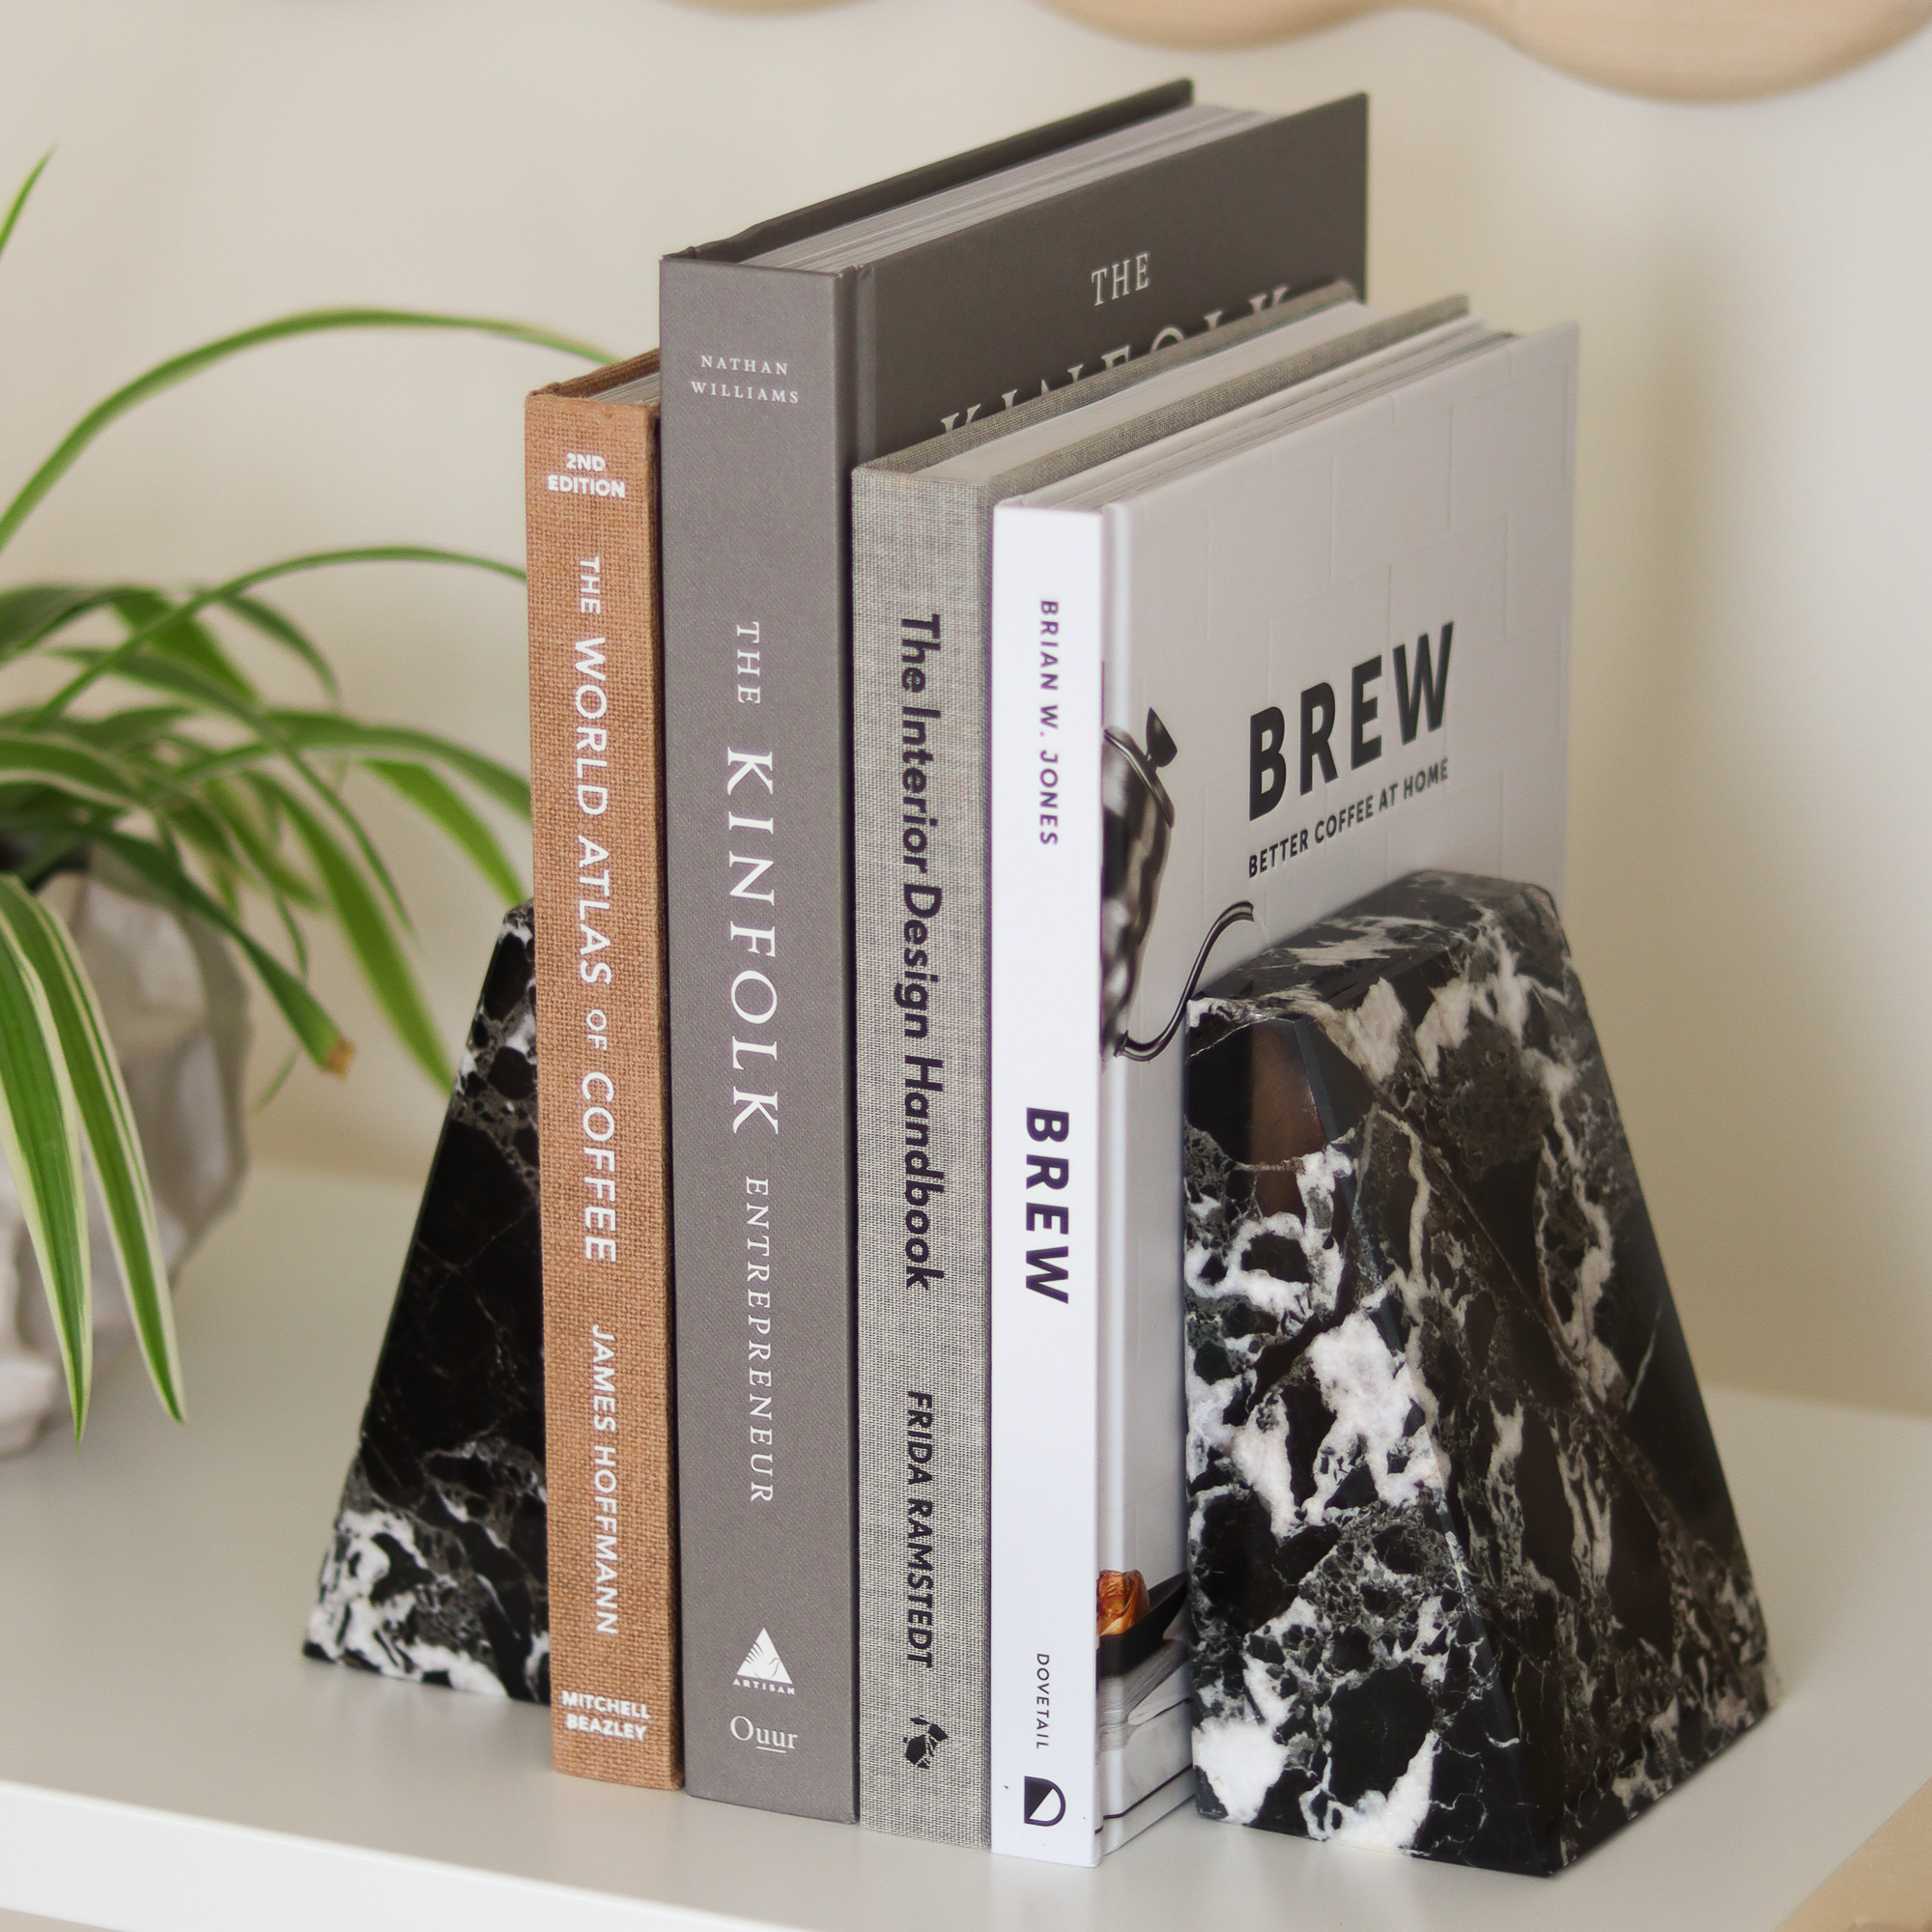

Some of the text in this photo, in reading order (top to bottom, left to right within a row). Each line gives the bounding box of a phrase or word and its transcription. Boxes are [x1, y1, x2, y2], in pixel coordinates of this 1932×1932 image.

[1091, 252, 1150, 307] THE
[691, 381, 800, 404] WILLIAMS
[700, 355, 789, 376] NATHAN
[547, 474, 626, 498] EDITION
[565, 452, 607, 472] 2ND
[1038, 600, 1060, 846] BRIAN W. JONES
[1249, 620, 1455, 821] BREW
[1248, 757, 1449, 880] BETTER COFFEE AT HOME
[574, 556, 616, 1263] THE WORLD ATLAS OF COFFEE
[894, 613, 945, 1291] The Interior Design Handbook
[726, 621, 780, 1503] THE KINFOLK ENTREPRENEUR
[1026, 1107, 1069, 1304] BREW
[592, 1323, 618, 1634] JAMES HOFFMANN
[907, 1389, 933, 1669] FRIDA RAMSTEDT
[561, 1690, 651, 1720] MITCHELL
[565, 1714, 647, 1742] BEAZLEY
[729, 1715, 799, 1751] Ouur
[732, 1678, 796, 1696] ARTISAN
[1036, 1652, 1050, 1749] DOVETAIL
